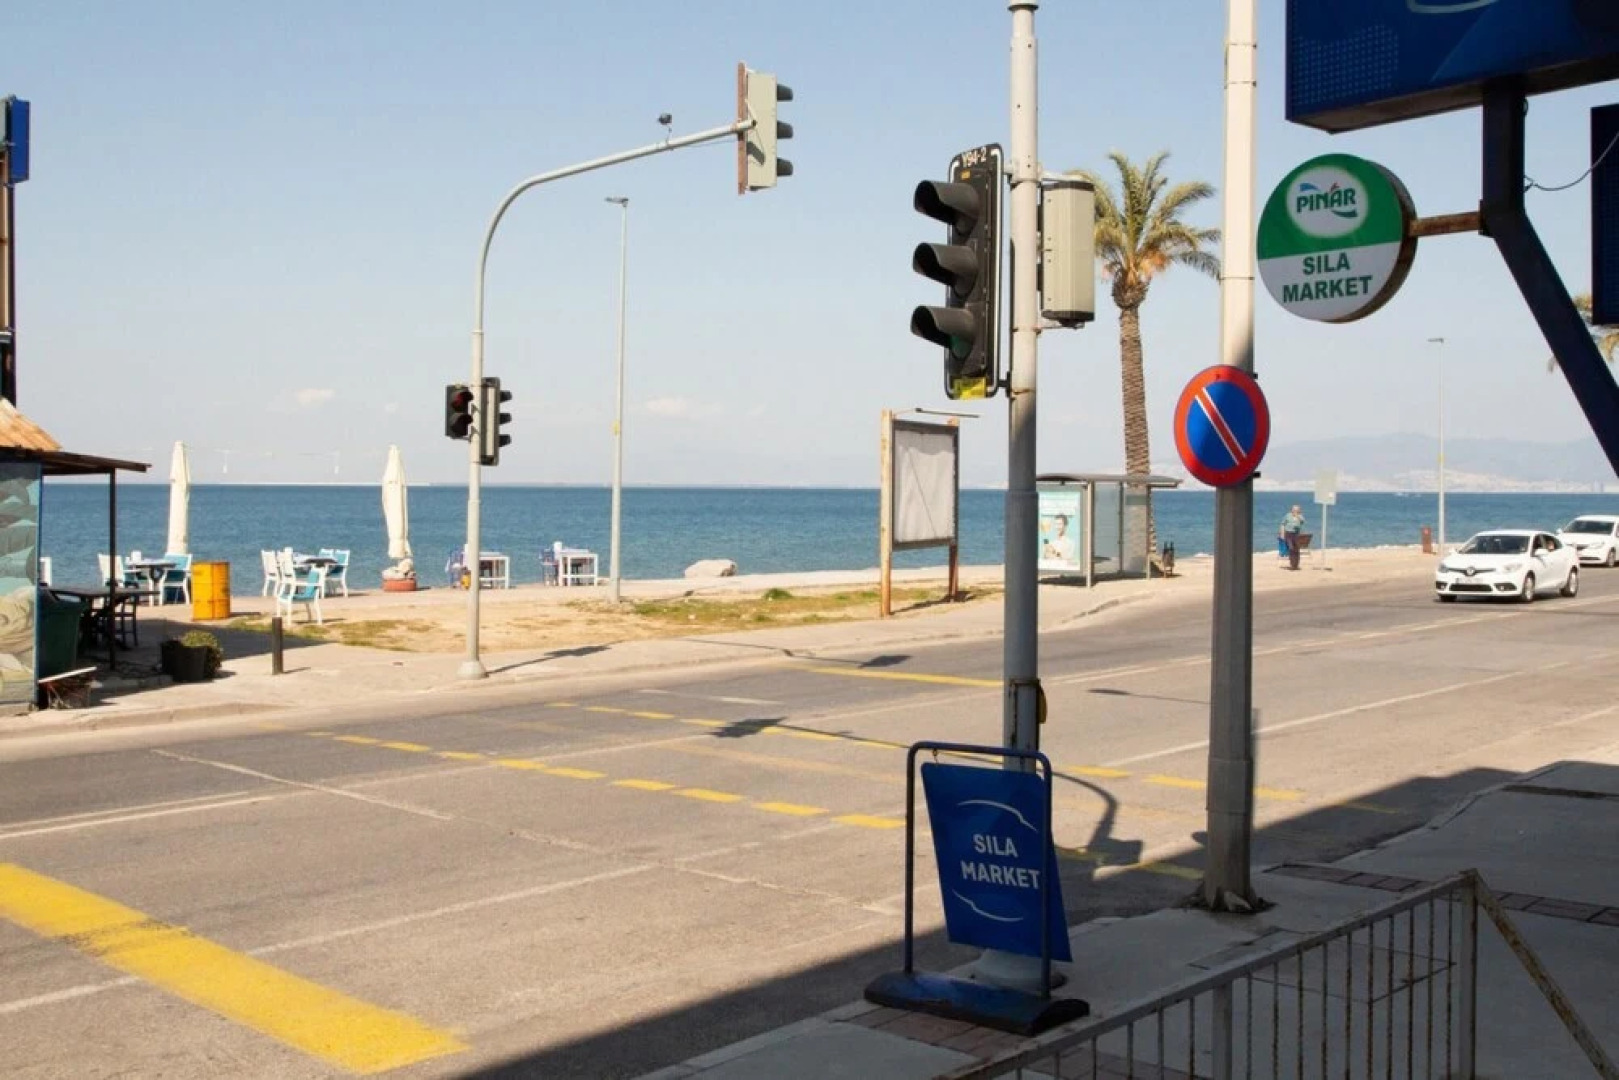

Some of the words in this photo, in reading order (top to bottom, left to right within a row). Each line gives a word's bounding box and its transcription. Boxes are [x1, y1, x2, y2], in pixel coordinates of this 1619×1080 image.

[1302, 252, 1350, 275] SILA
[1283, 275, 1373, 303] MARKET
[972, 833, 1018, 858] SILA
[960, 860, 1040, 890] MARKET
